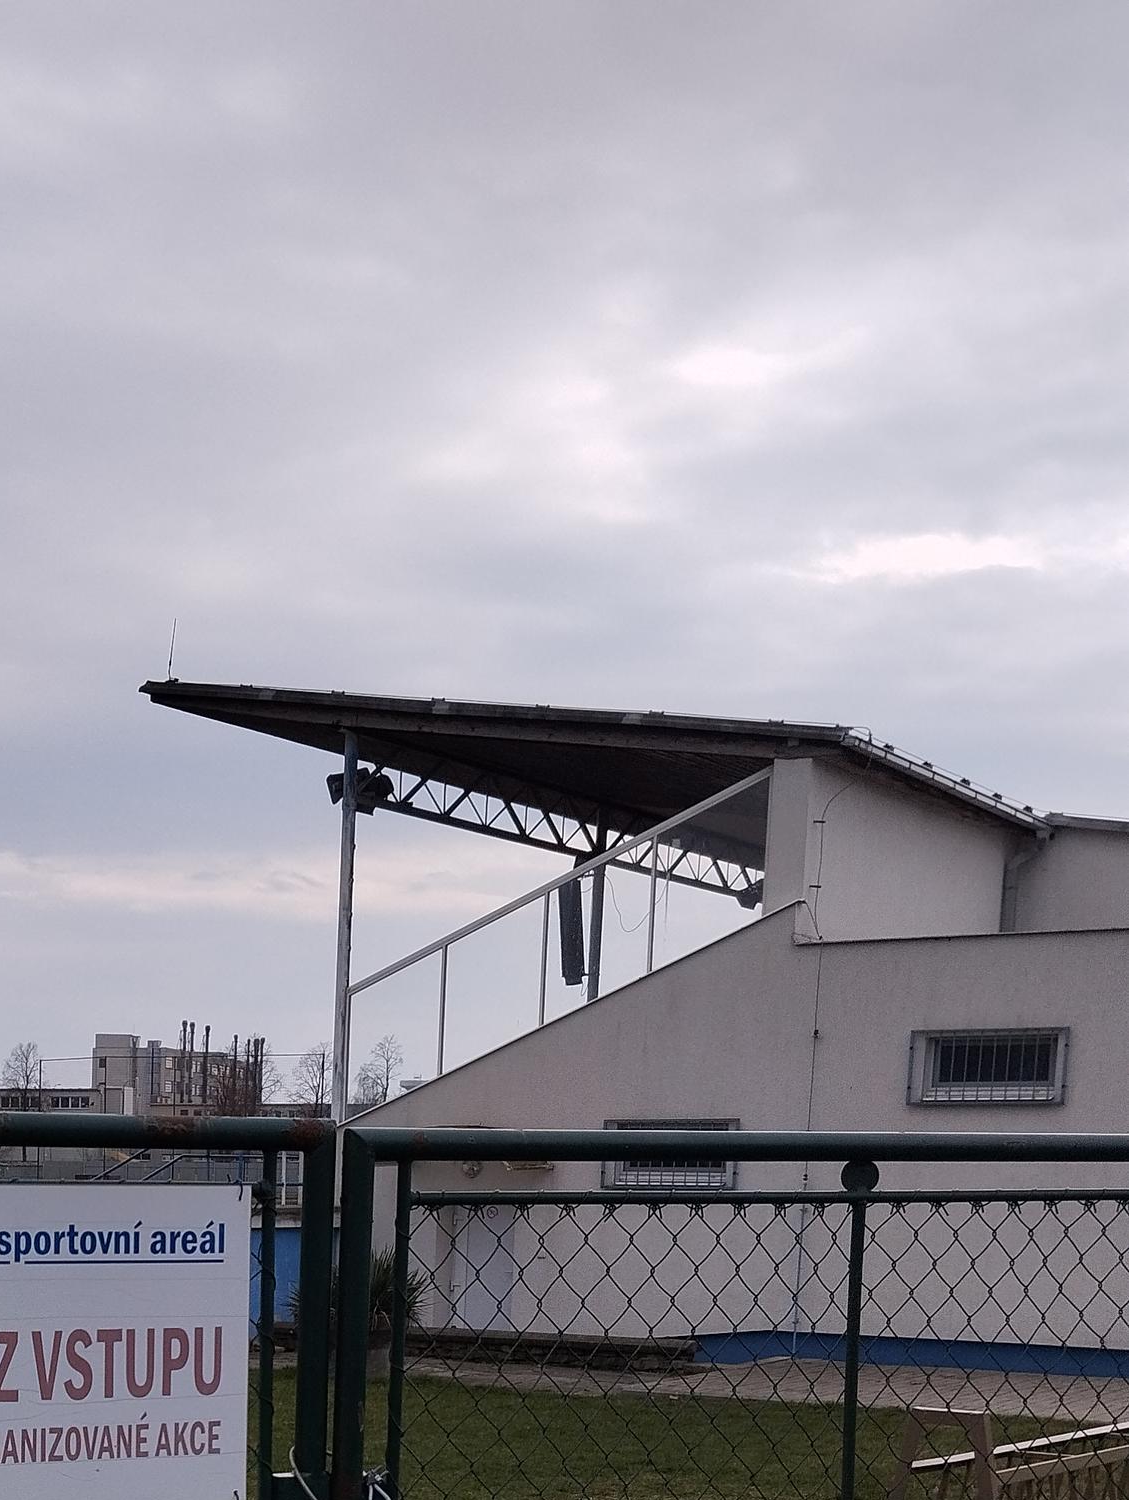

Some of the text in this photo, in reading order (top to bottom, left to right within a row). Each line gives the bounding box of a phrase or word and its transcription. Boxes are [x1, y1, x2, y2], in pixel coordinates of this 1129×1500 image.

[150, 1220, 226, 1255] areál
[31, 1326, 223, 1400] VSTUPU
[155, 1420, 222, 1456] AKCE
